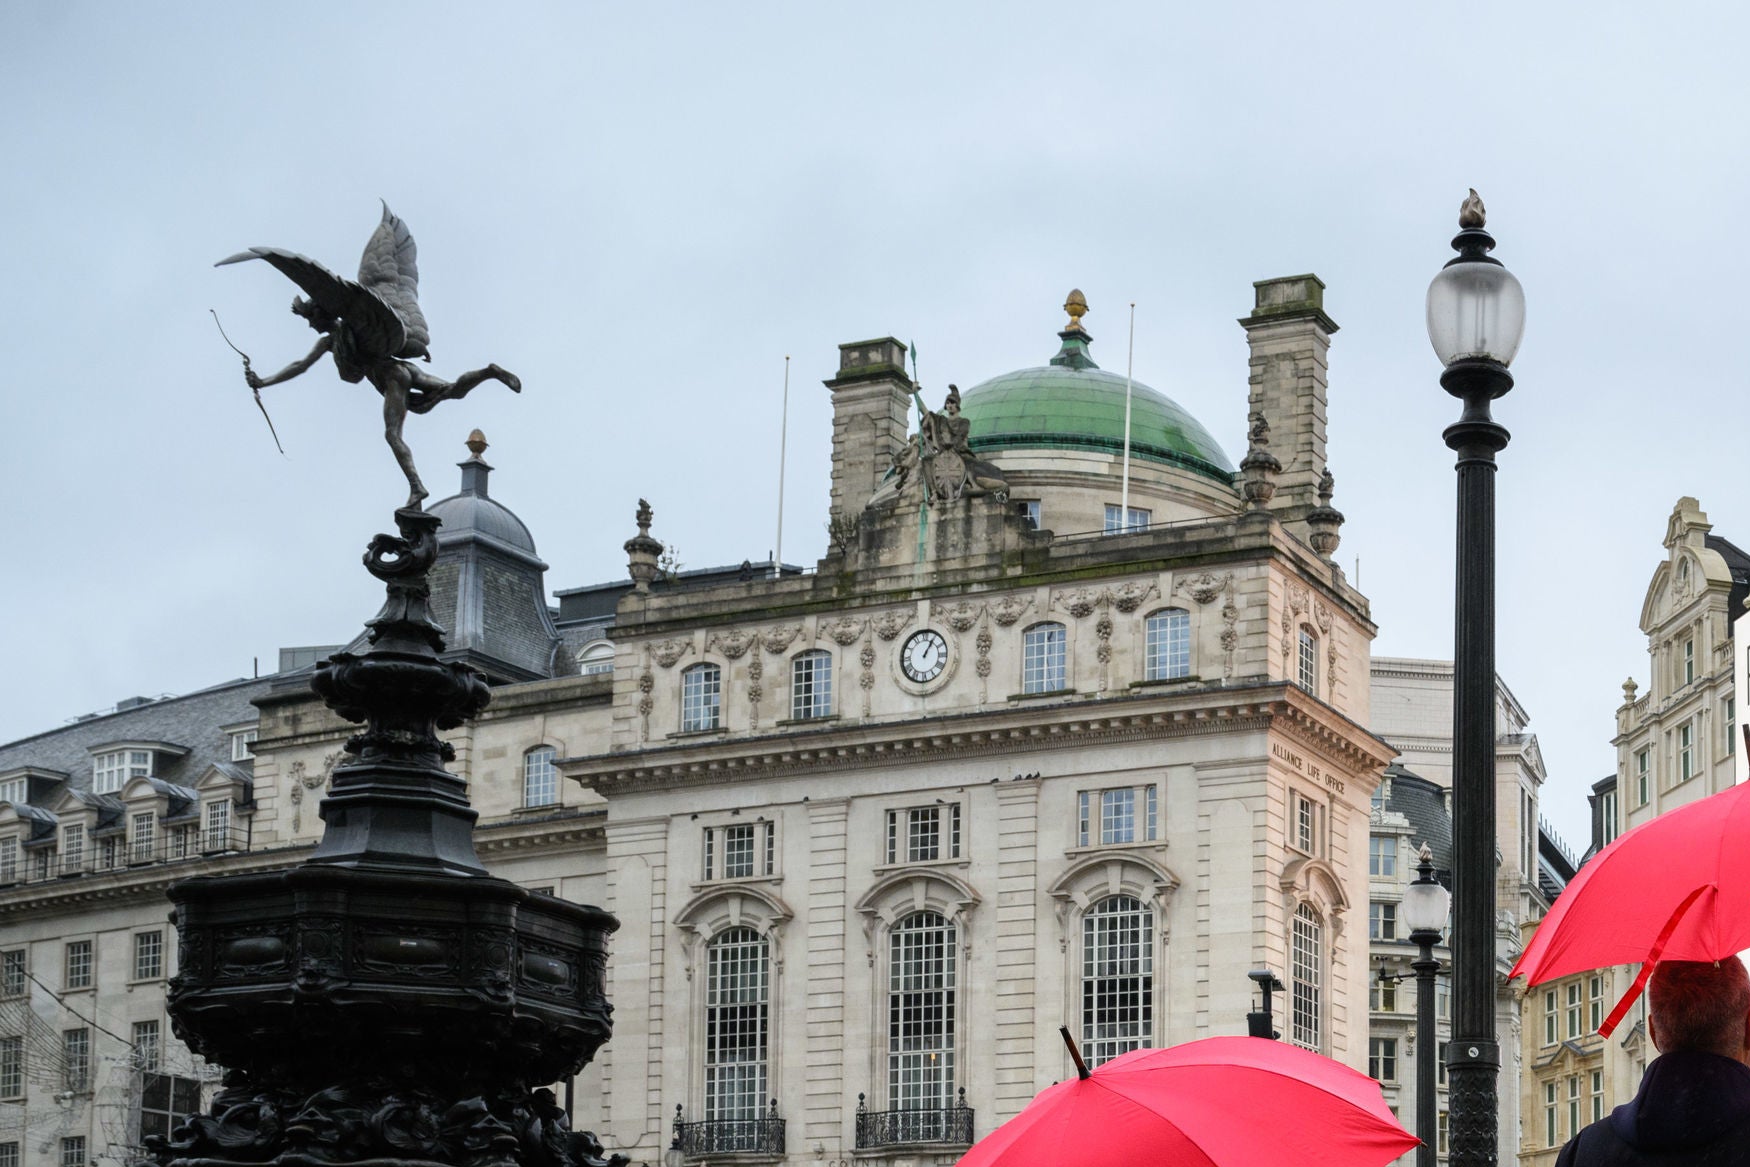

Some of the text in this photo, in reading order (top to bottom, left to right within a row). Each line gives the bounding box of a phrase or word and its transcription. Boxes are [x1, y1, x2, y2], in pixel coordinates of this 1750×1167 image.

[1272, 743, 1345, 794] ALLIANCE LIFE OFFICE
[933, 1154, 959, 1165] FIR
